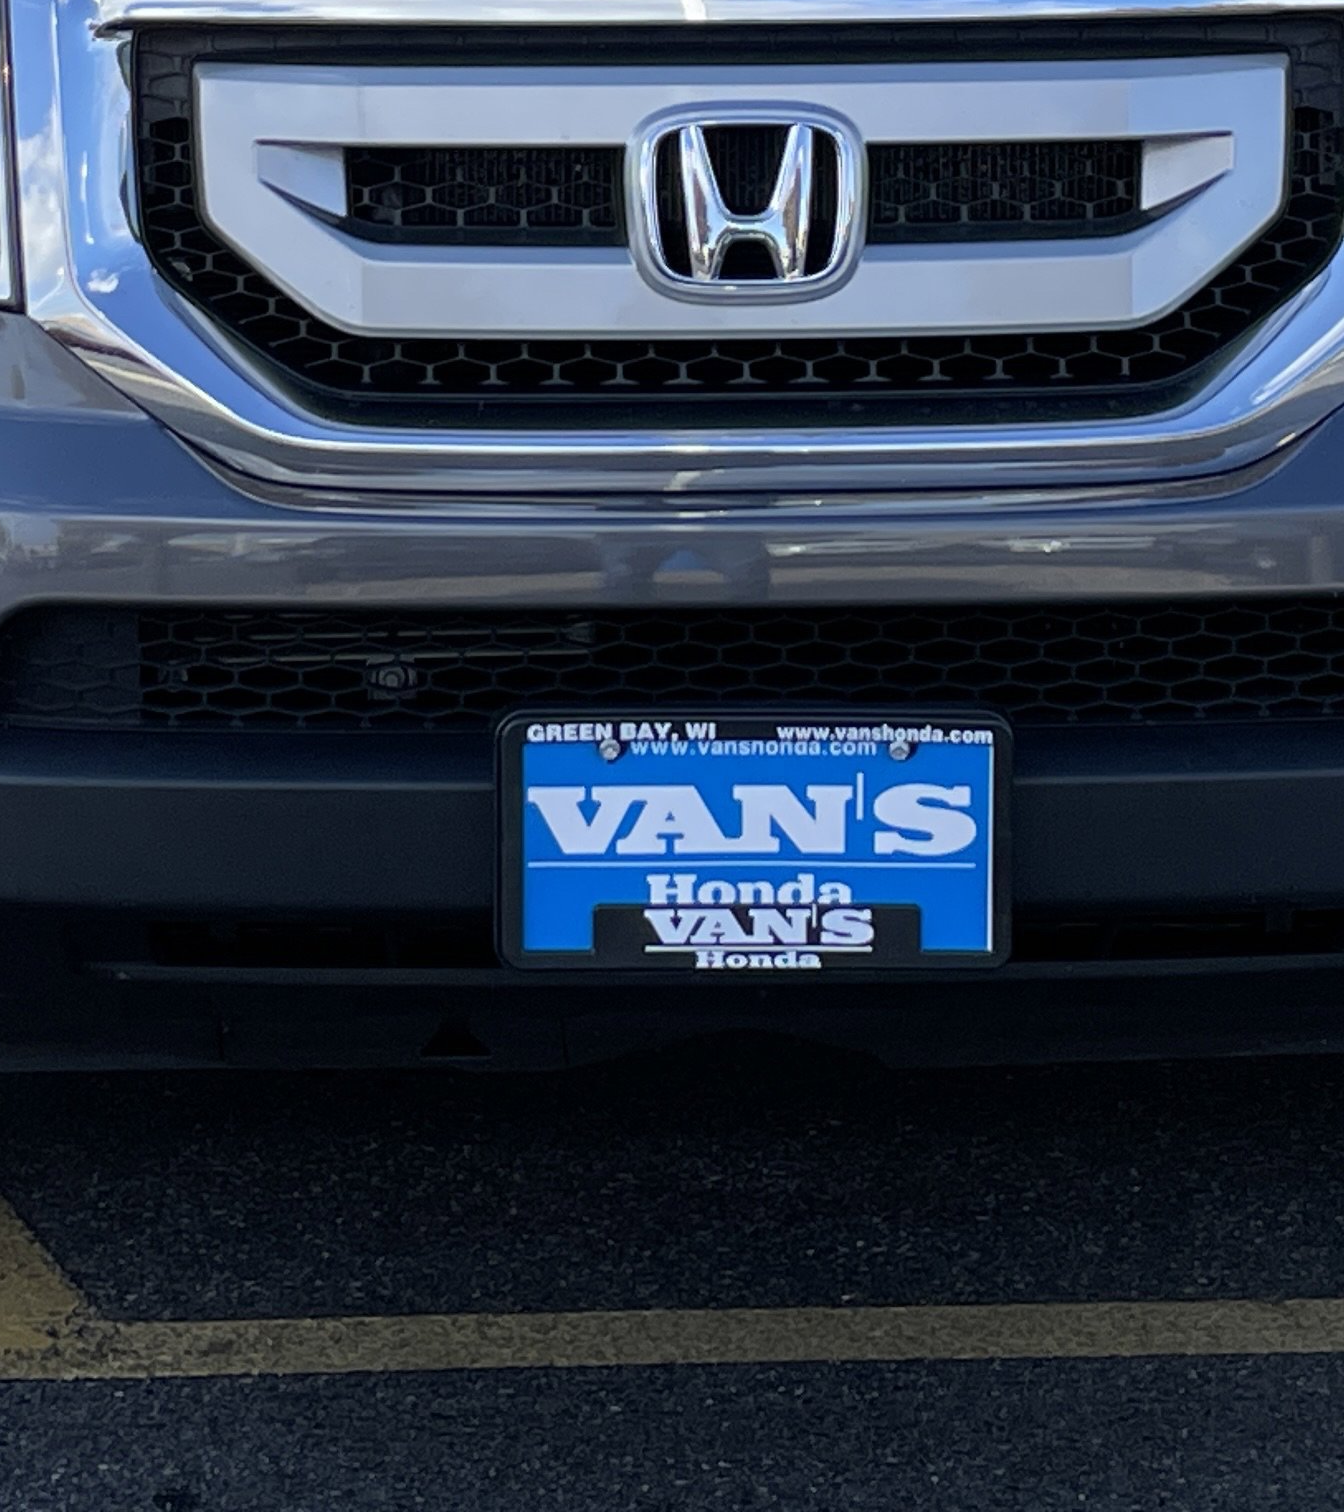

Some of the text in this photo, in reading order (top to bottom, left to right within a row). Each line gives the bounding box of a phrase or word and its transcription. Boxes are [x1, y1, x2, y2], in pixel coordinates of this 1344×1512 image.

[527, 722, 717, 742] GREEN BAY, WI
[776, 723, 994, 744] www.vanshonda.com
[527, 771, 978, 857] VAN'S
[646, 873, 853, 905] Honda
[644, 903, 875, 946] VAN'S
[694, 950, 823, 970] Honda
